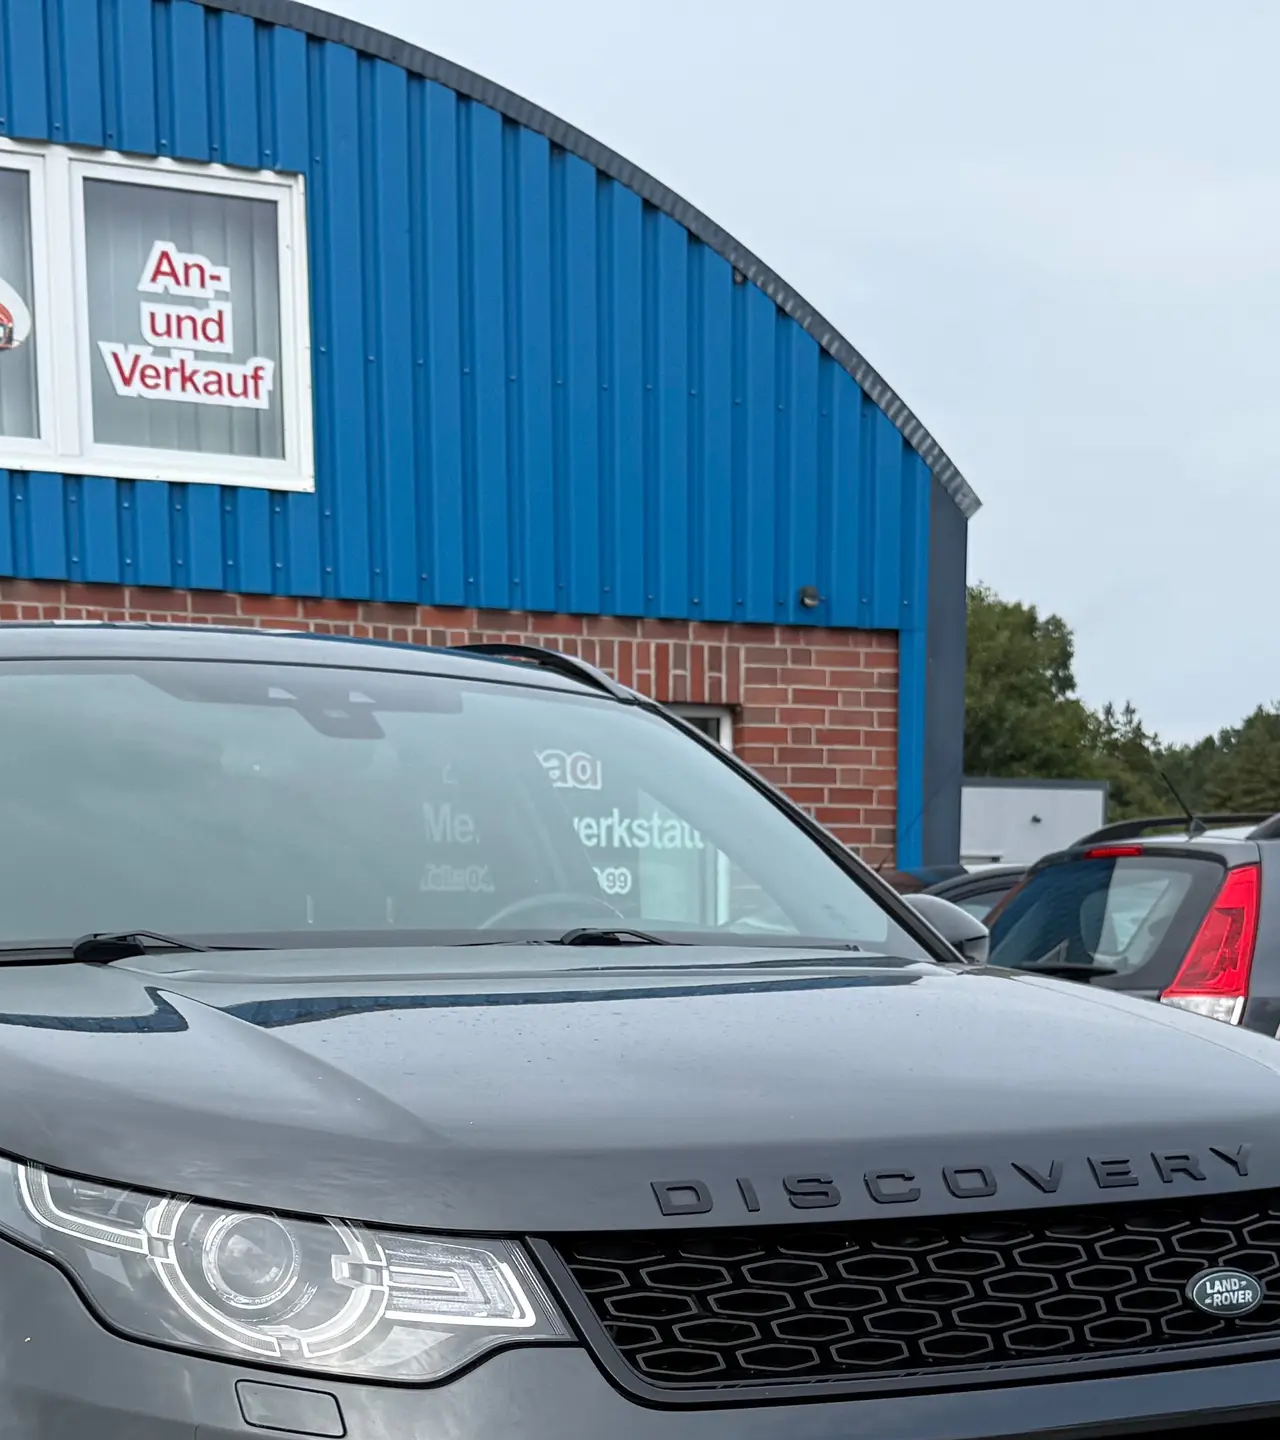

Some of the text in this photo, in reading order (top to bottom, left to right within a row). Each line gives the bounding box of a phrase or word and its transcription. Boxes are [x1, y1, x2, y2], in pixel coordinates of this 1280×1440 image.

[149, 250, 222, 289] An-
[149, 308, 225, 343] und
[111, 351, 267, 400] Verkauf
[650, 1144, 1254, 1216] DISCOVERY
[1205, 1278, 1240, 1294] LAND
[1213, 1289, 1253, 1307] ROVER
